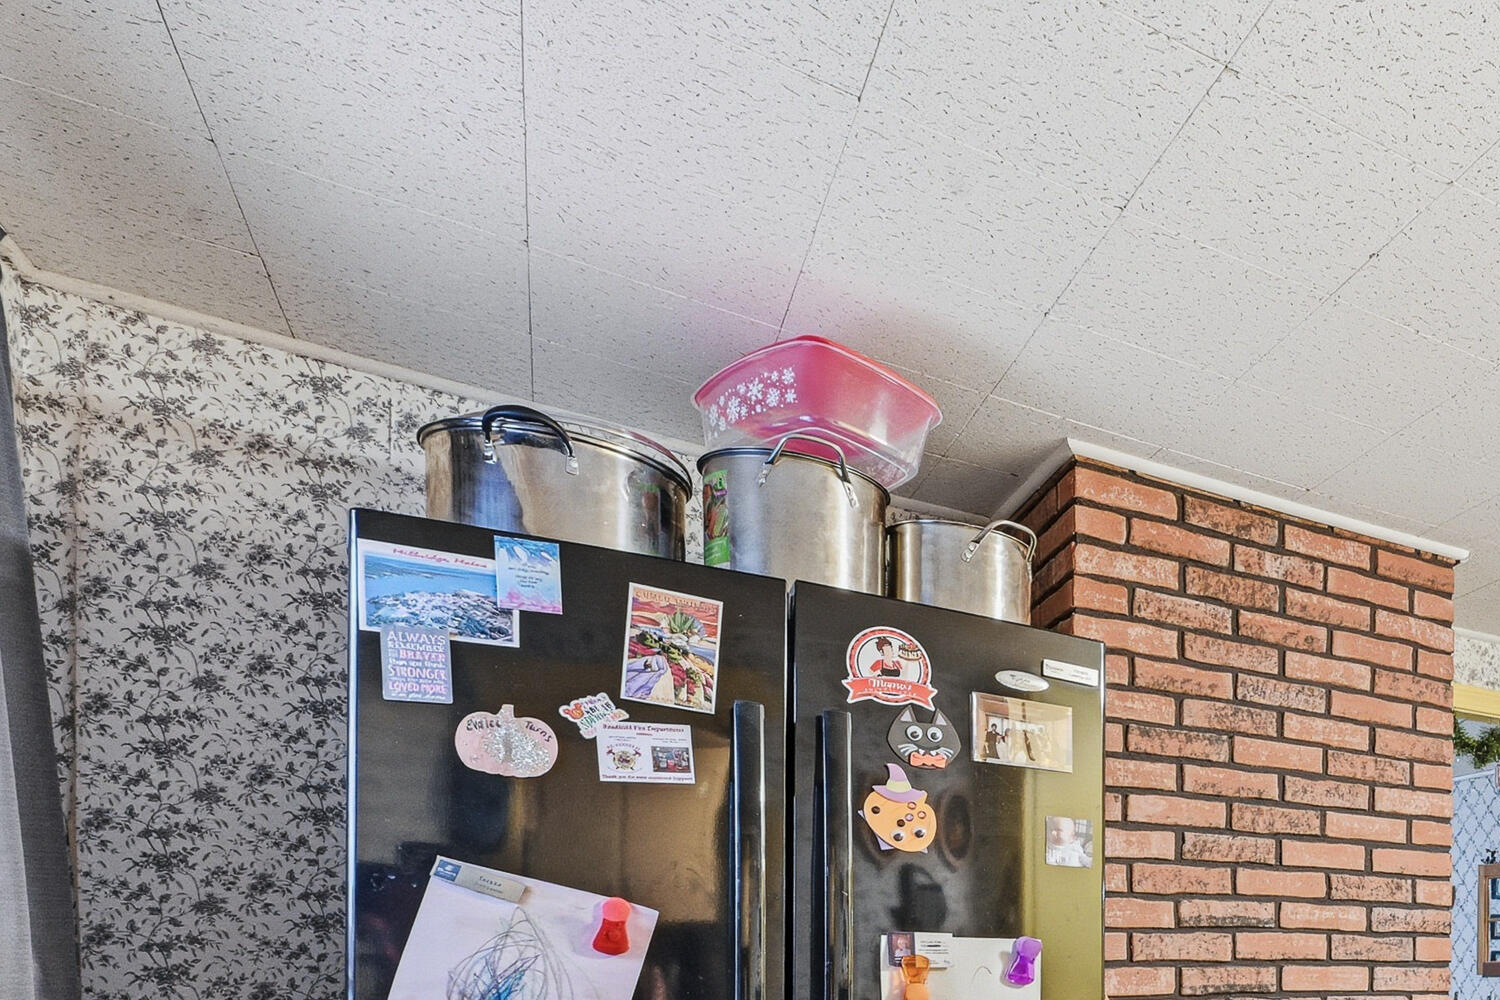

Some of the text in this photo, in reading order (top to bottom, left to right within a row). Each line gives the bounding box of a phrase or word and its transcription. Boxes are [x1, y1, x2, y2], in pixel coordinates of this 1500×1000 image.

[387, 631, 446, 645] ALWAYS
[400, 649, 446, 662] BRAVER
[388, 665, 447, 679] STRONGER
